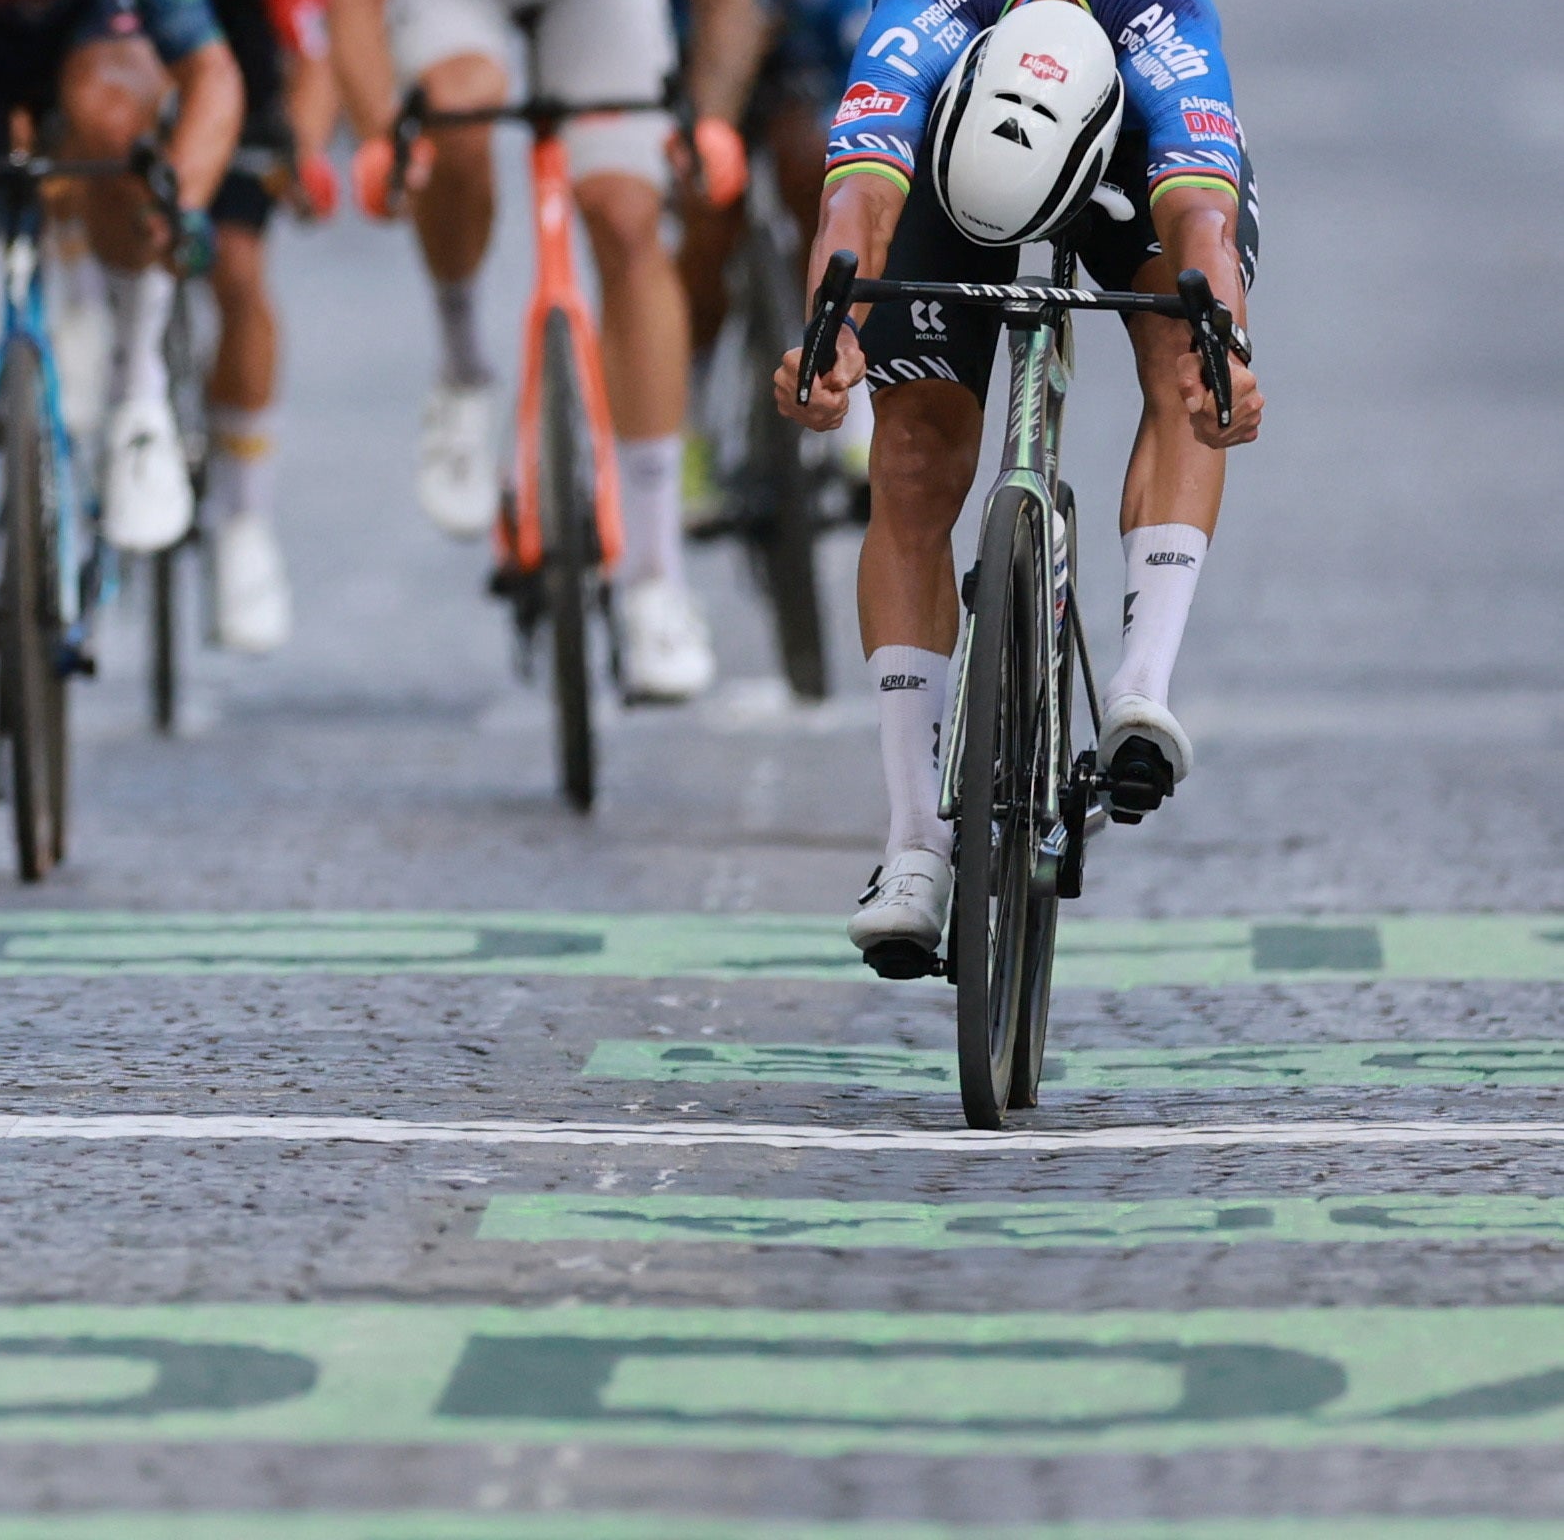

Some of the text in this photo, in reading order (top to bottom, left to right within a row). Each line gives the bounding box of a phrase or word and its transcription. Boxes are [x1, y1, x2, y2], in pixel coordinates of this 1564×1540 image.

[1023, 56, 1065, 82] Alpecin
[840, 87, 893, 112] pecin
[957, 283, 1098, 303] CANYON
[915, 332, 949, 342] KOLOS
[1008, 343, 1028, 445] CANYON
[1145, 551, 1175, 564] AERO
[880, 675, 906, 688] AERO
